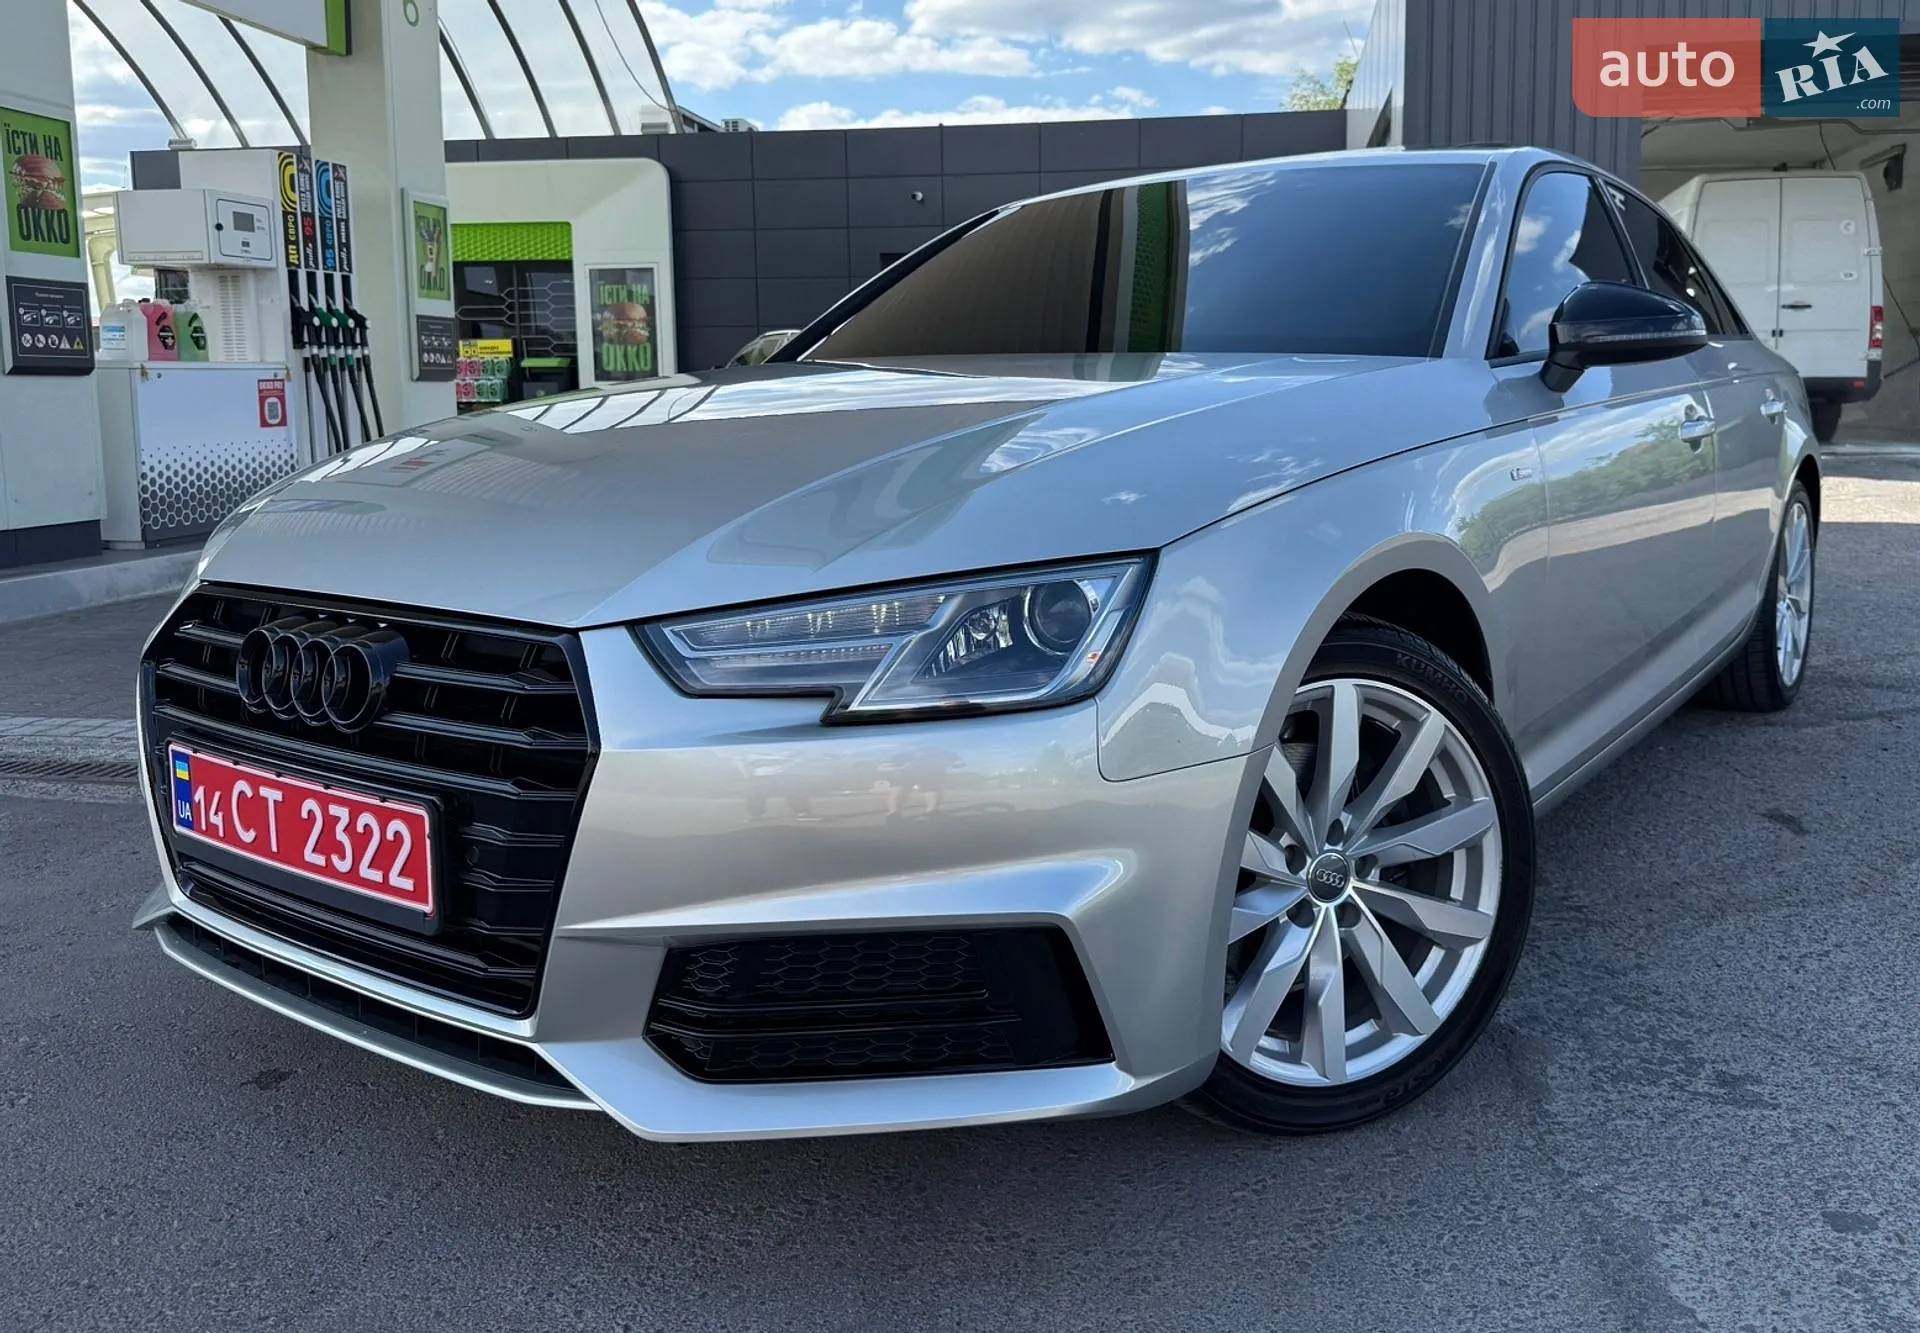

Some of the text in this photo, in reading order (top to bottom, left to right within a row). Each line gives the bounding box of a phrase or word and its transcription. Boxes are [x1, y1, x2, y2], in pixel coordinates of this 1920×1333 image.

[4, 122, 63, 162] ЇСТИ НА
[598, 280, 650, 305] ЇСТИ НА
[178, 799, 193, 822] UA
[301, 798, 415, 892] 2322
